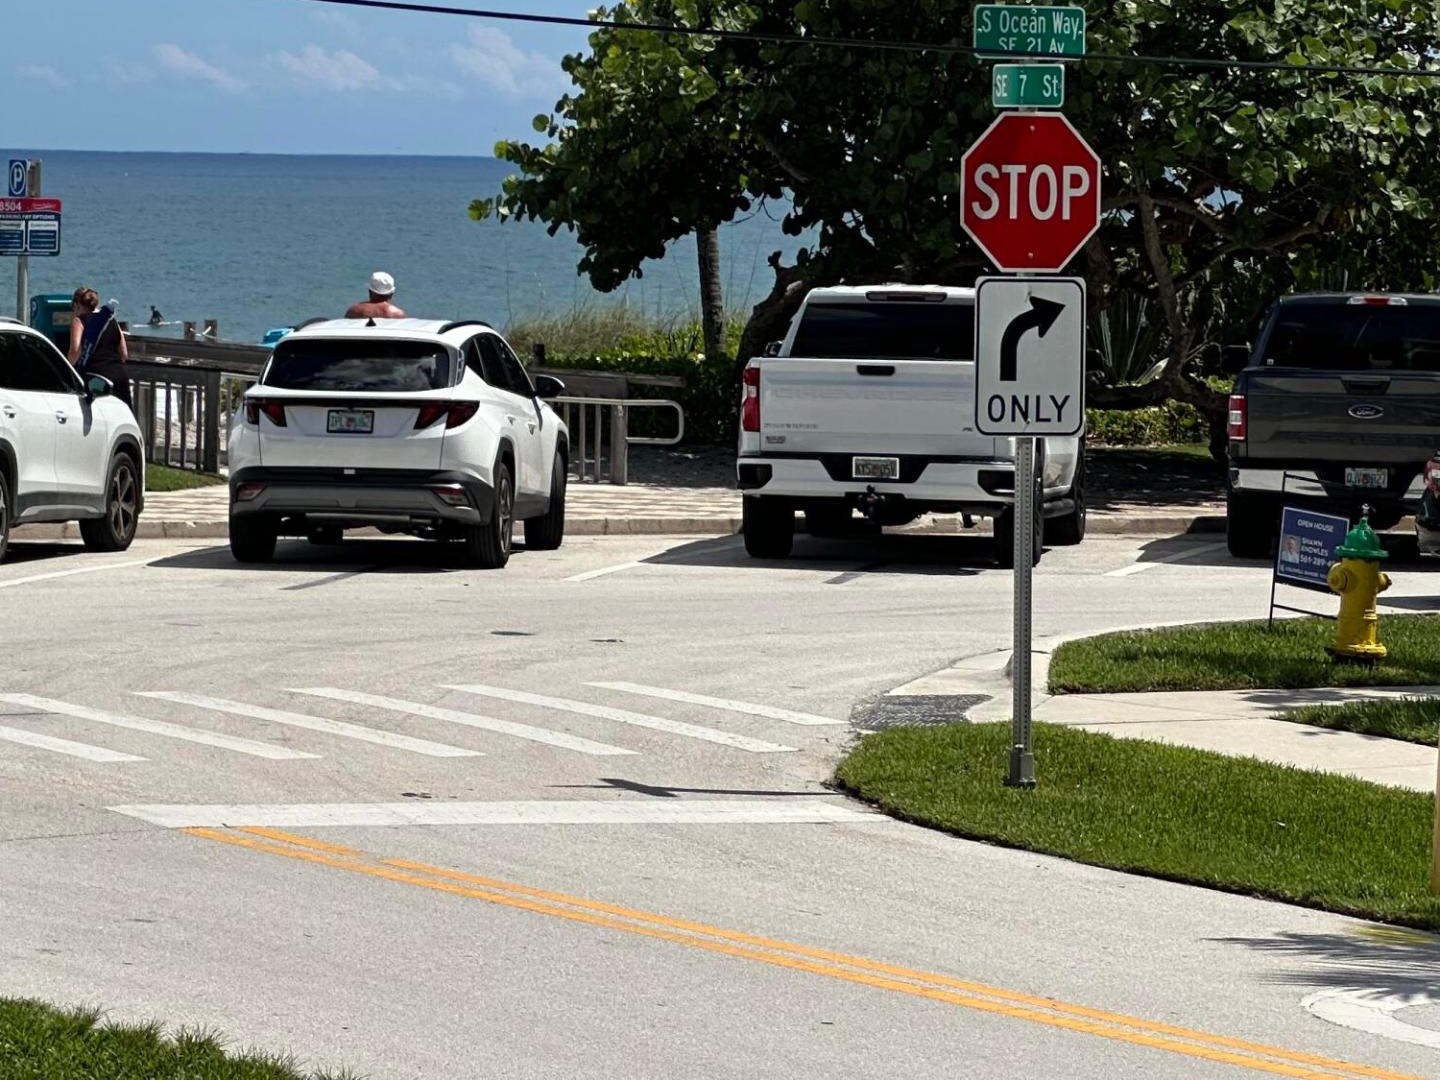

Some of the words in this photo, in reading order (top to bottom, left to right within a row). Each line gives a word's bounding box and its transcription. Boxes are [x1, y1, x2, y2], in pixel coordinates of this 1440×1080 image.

[982, 10, 992, 33] S
[999, 10, 1046, 34] Ocean
[1052, 11, 1080, 40] Way
[1026, 37, 1042, 52] 21
[1049, 38, 1065, 54] Av
[995, 74, 1008, 98] SE
[1019, 74, 1028, 98] 7
[1042, 74, 1059, 98] St
[971, 163, 1090, 220] STOP
[987, 394, 1071, 423] ONLY
[1297, 518, 1313, 528] OPEN
